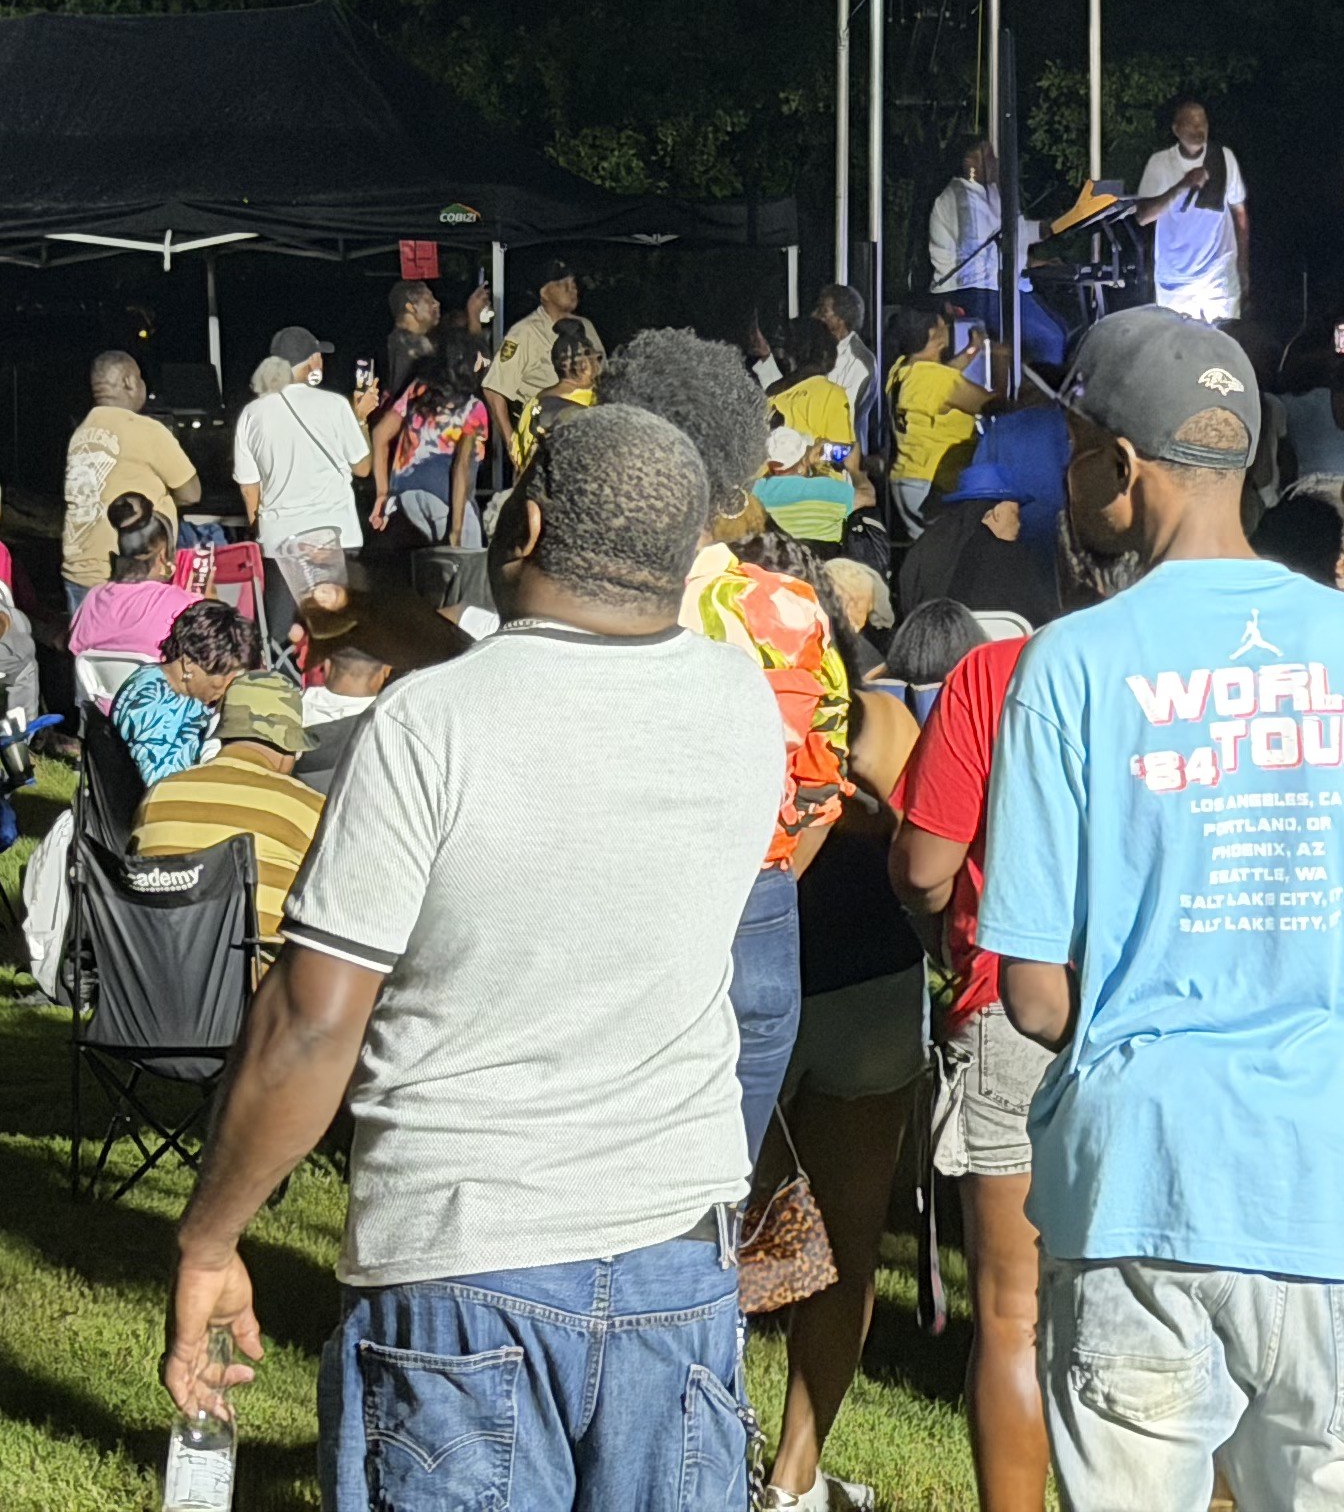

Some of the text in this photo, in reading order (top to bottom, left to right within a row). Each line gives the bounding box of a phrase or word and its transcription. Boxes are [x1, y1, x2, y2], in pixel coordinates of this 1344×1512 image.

[439, 212, 477, 223] COBIZI
[1129, 745, 1221, 793] '84
[1190, 797, 1225, 814] LOS
[1318, 791, 1343, 807] CA
[1203, 816, 1332, 837] PORTLAND, OR
[1295, 841, 1326, 857] AZ
[126, 867, 200, 887] ademy
[1295, 866, 1328, 882] WA
[1179, 894, 1225, 909] SALT
[1226, 892, 1275, 907] LAKE
[1279, 891, 1327, 907] CITY,
[1179, 917, 1223, 933] SALT
[1224, 916, 1275, 931] LAKE
[1279, 916, 1327, 933] CITY,
